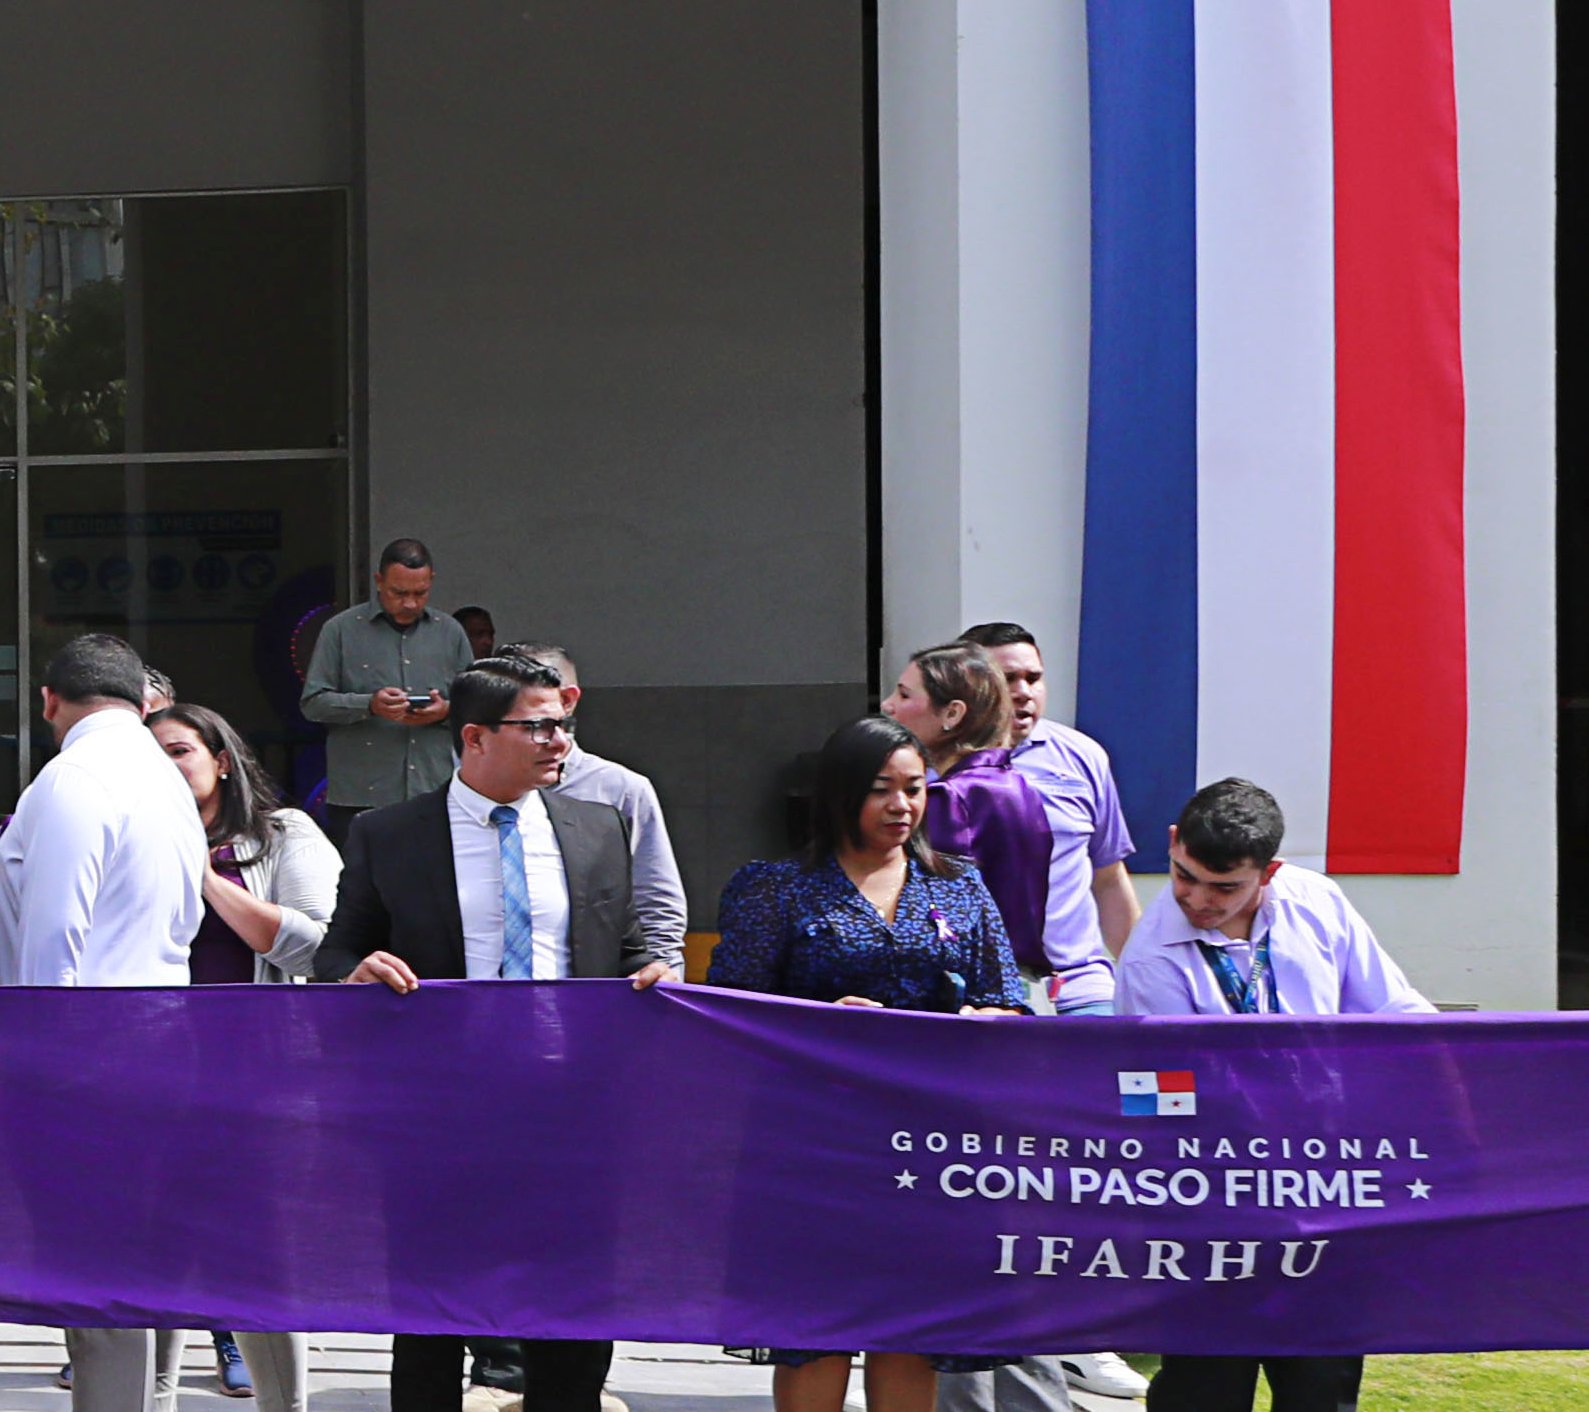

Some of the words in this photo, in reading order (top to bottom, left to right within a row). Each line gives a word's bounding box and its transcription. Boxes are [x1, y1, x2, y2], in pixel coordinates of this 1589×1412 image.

[891, 1130, 1145, 1160] GOBIERNO
[1178, 1135, 1430, 1161] NACIONAL
[939, 1164, 1055, 1206] CON
[1071, 1166, 1209, 1207] PASO
[1225, 1169, 1385, 1209] FIRME
[993, 1234, 1329, 1283] IFARHU
